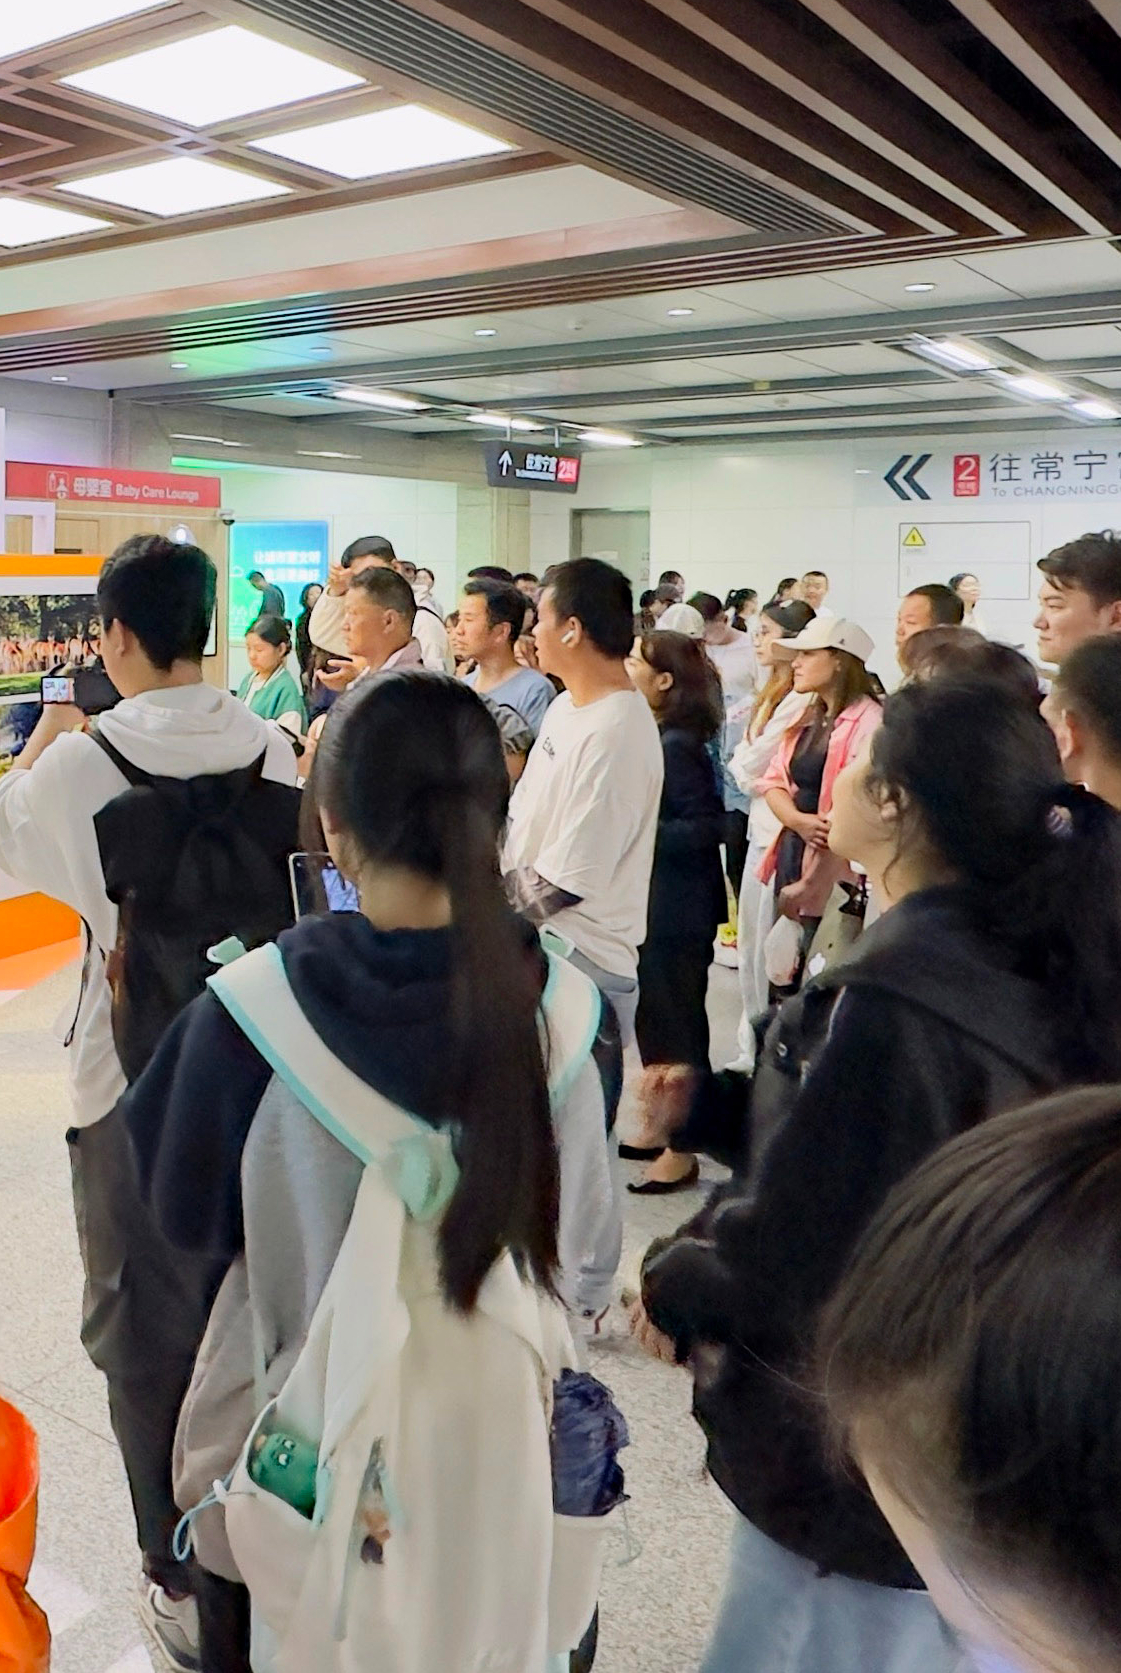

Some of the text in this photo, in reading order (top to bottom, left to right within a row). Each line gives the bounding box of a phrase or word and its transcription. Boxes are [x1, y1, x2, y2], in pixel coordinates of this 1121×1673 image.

[958, 457, 976, 480] 2
[990, 450, 1121, 483] 往常宁
[73, 477, 199, 503] 母婴室 Baby Care Lounge
[992, 484, 1121, 497] To CHANGNINGG
